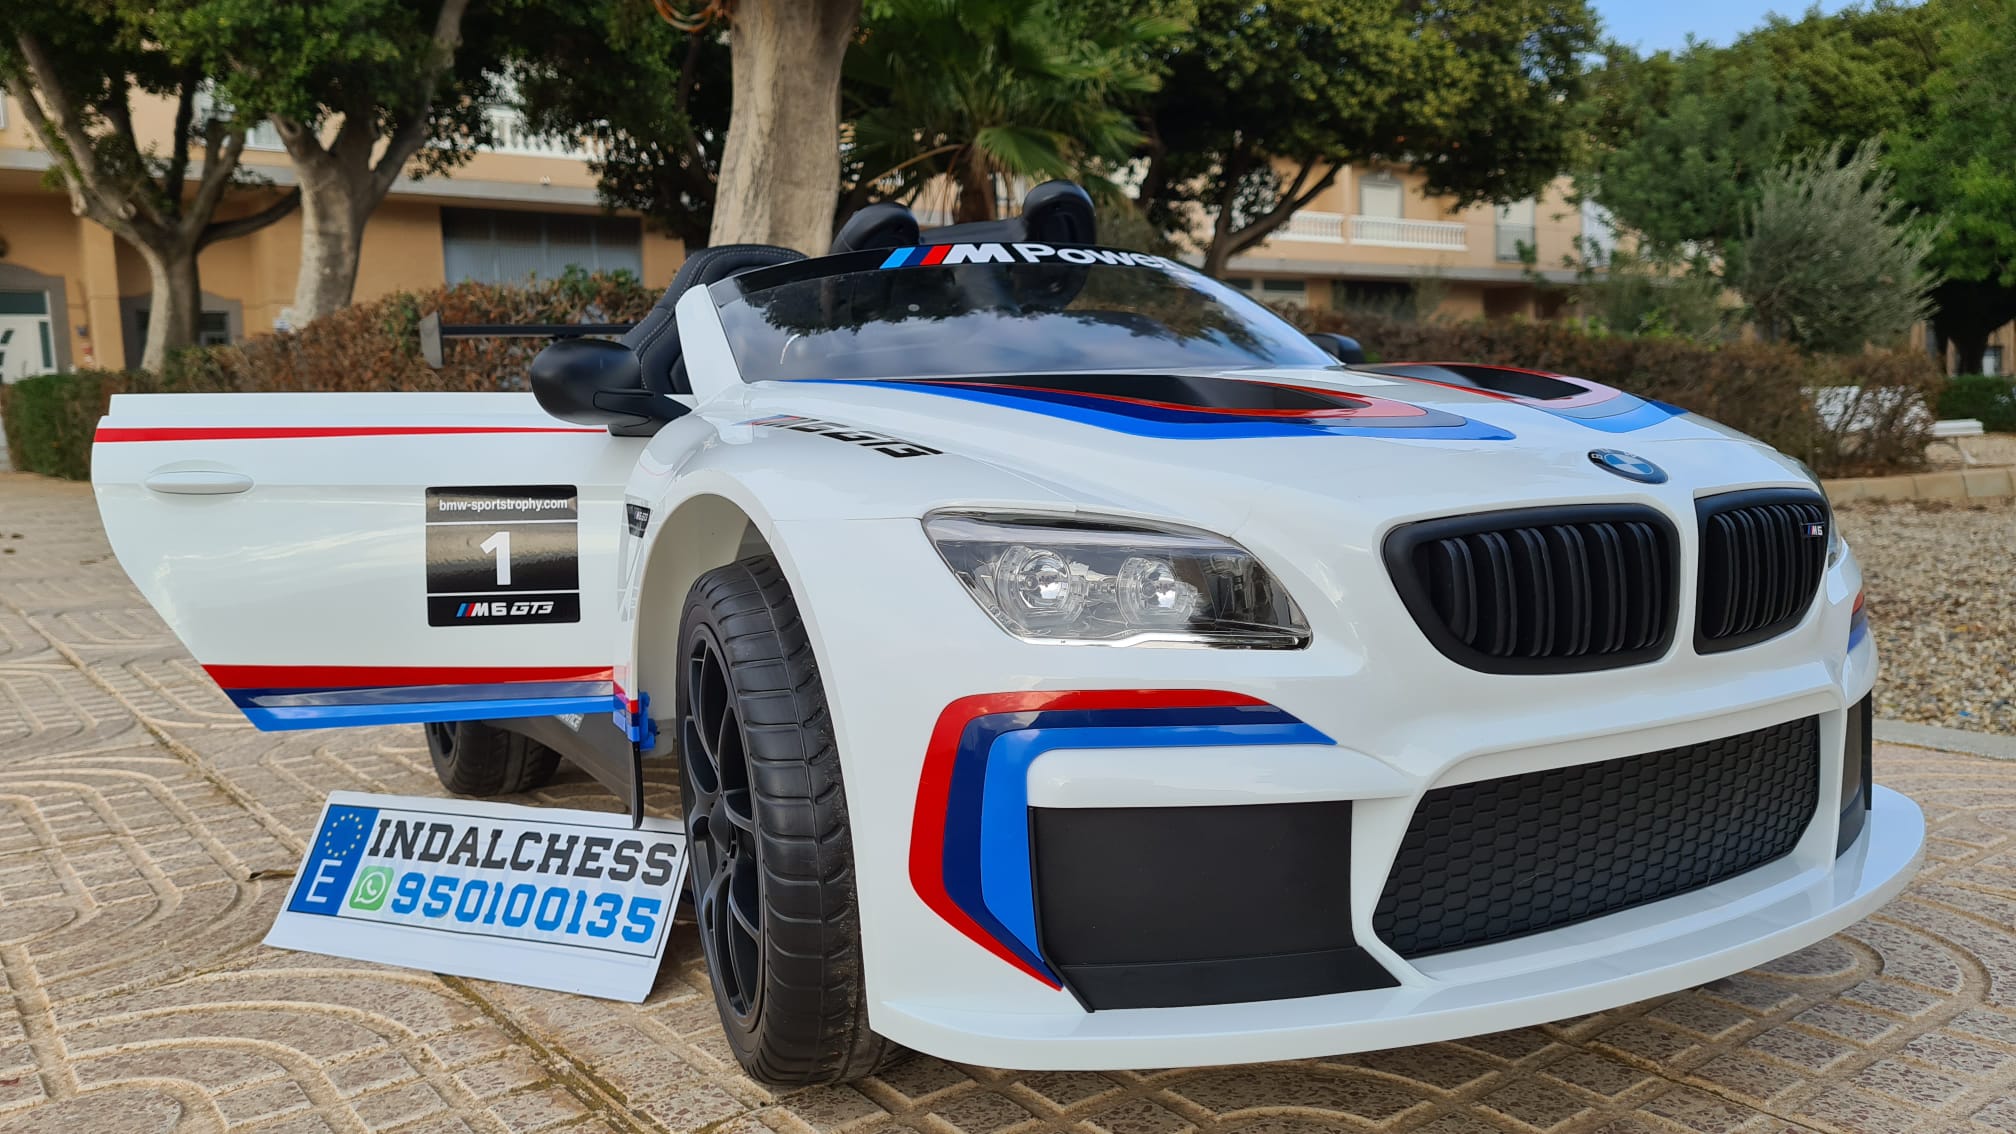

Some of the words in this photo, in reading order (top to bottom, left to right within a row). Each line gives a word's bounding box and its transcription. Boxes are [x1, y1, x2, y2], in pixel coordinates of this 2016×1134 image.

[439, 498, 568, 512] bmw-sportstrophy.com
[479, 531, 512, 586] 1
[470, 602, 507, 617] M6
[510, 601, 554, 616] GT3
[368, 818, 677, 886] INDALCHESS
[305, 858, 342, 904] E
[390, 872, 662, 944] 950100135
